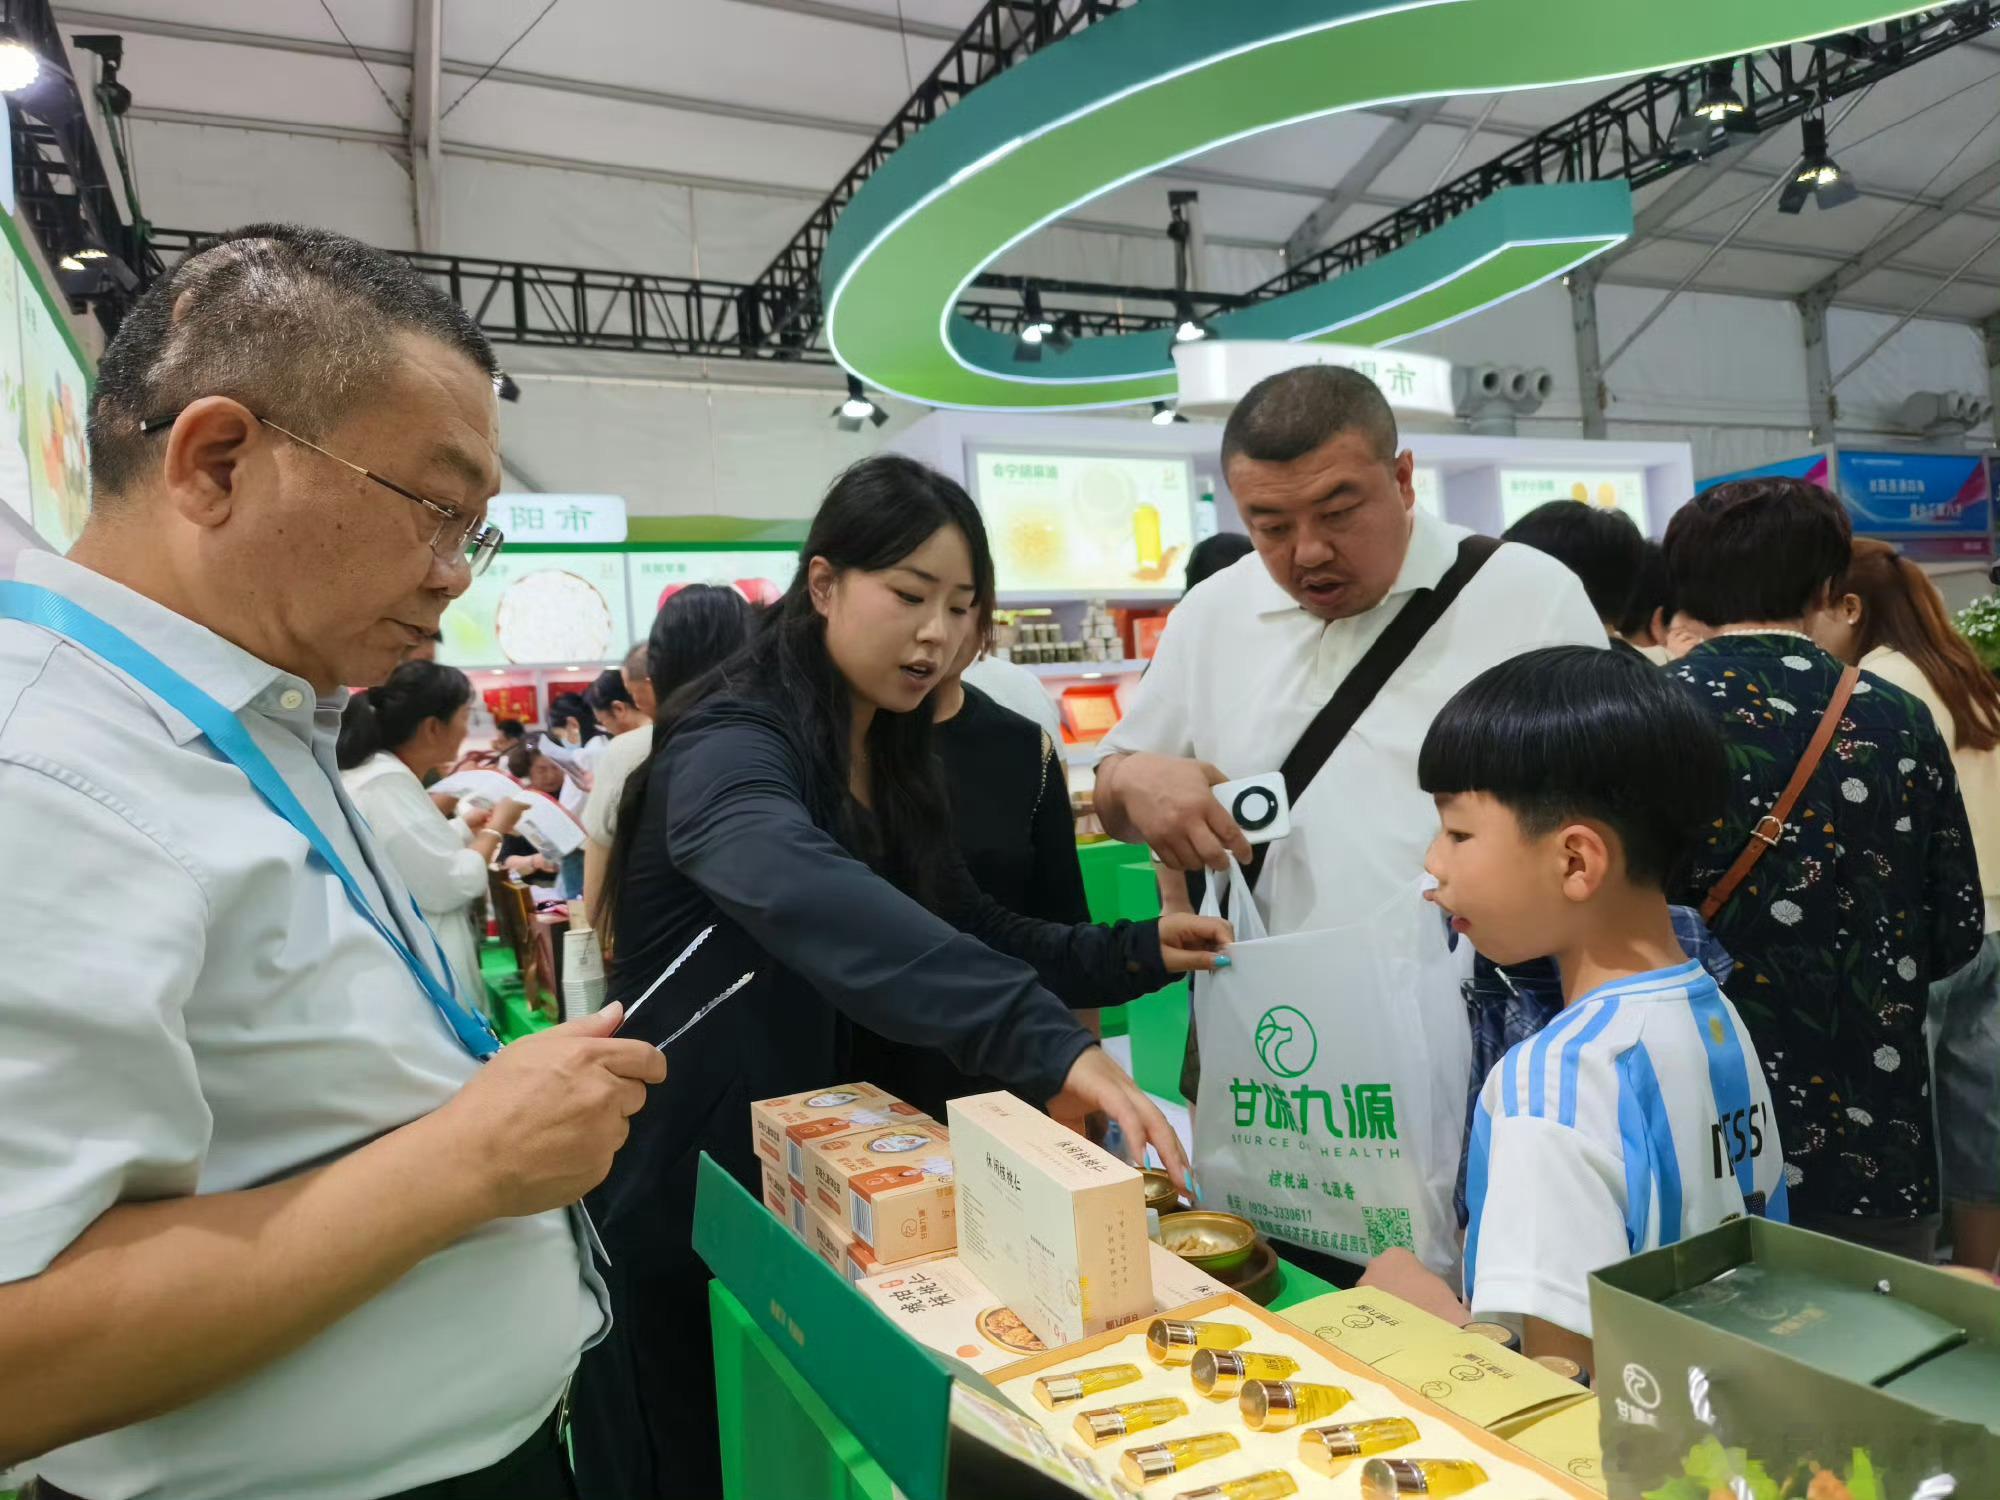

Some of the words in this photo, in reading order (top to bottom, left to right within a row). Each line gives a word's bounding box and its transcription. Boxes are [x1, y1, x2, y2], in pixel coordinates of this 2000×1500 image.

[1229, 1077, 1398, 1141] 甘味九源
[985, 1151, 1022, 1192] 休闲核桃仁
[1320, 1147, 1400, 1159] HEALTH
